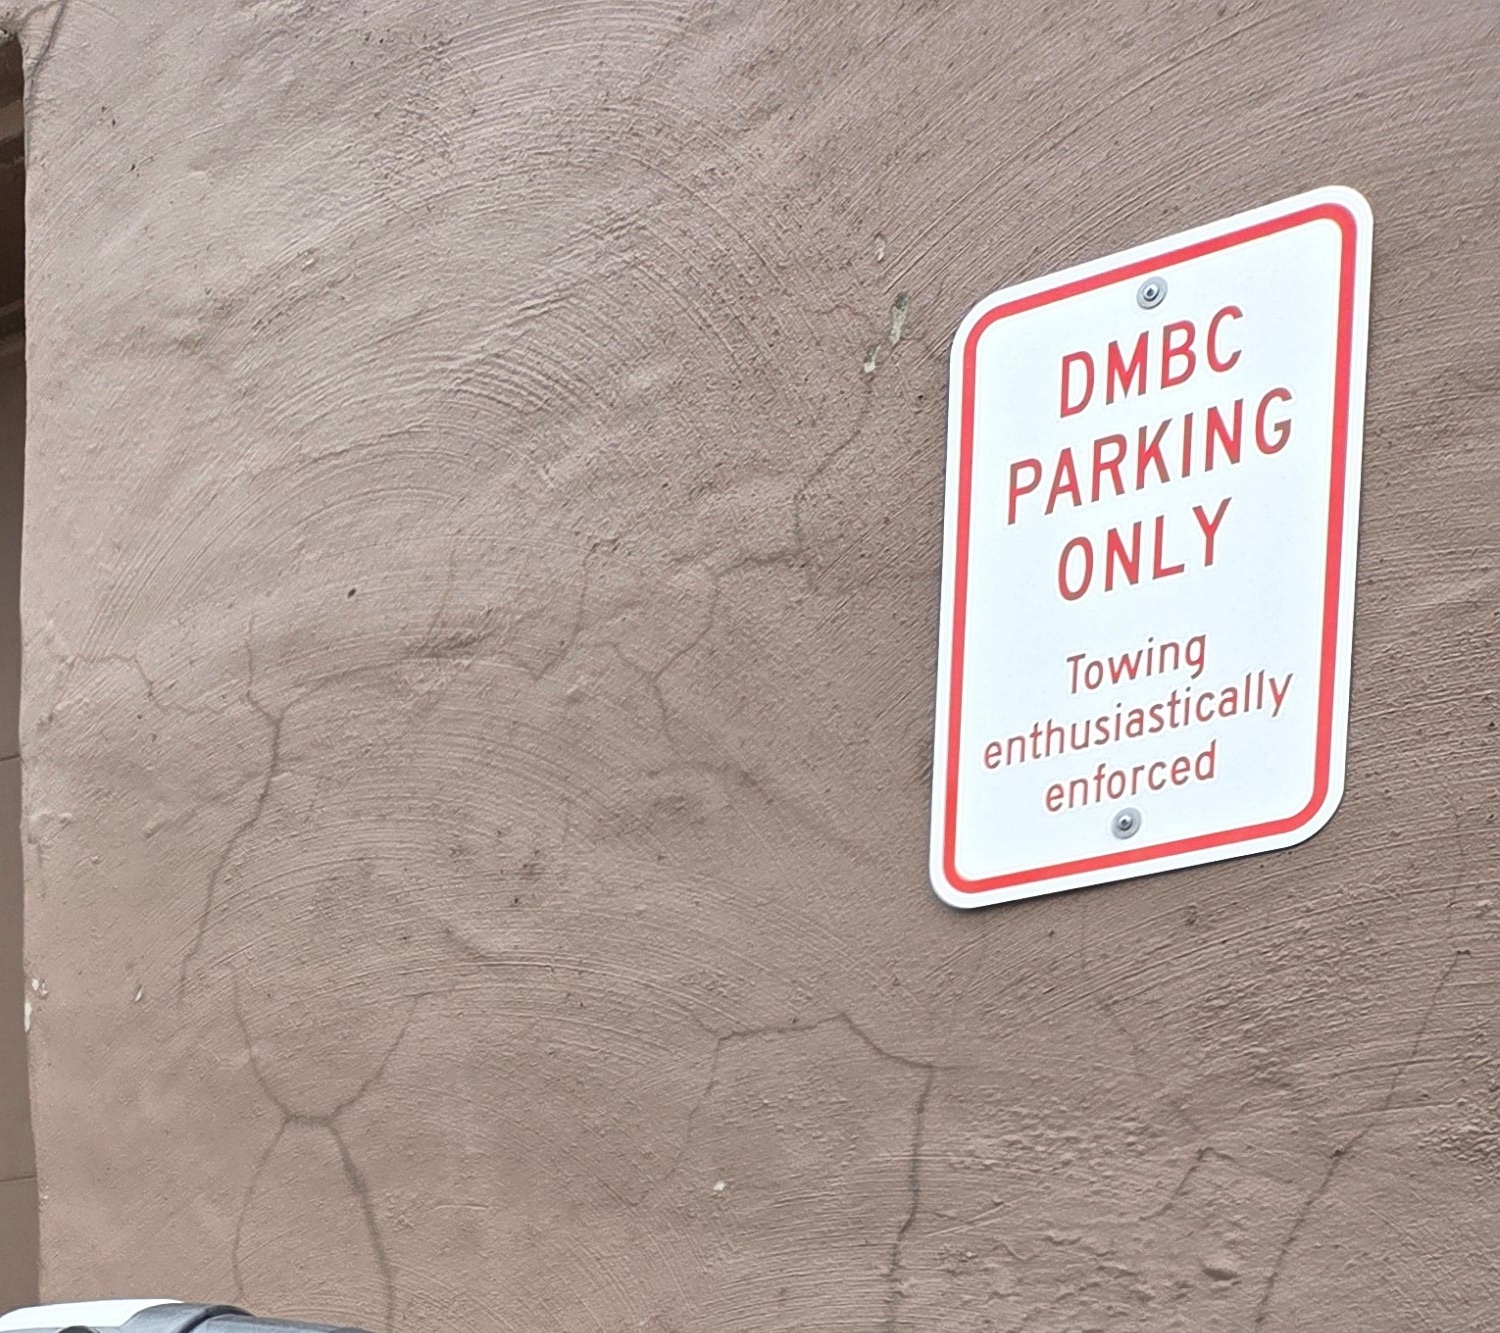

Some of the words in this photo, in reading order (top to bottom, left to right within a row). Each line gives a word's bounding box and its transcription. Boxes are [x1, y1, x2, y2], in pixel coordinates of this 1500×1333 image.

[1058, 304, 1244, 420] DMBC
[1006, 386, 1294, 526] PARKING
[1057, 497, 1233, 601] ONLY
[1066, 634, 1208, 696] Towing
[982, 670, 1294, 771] enthusiastically
[1044, 740, 1218, 812] enforced
